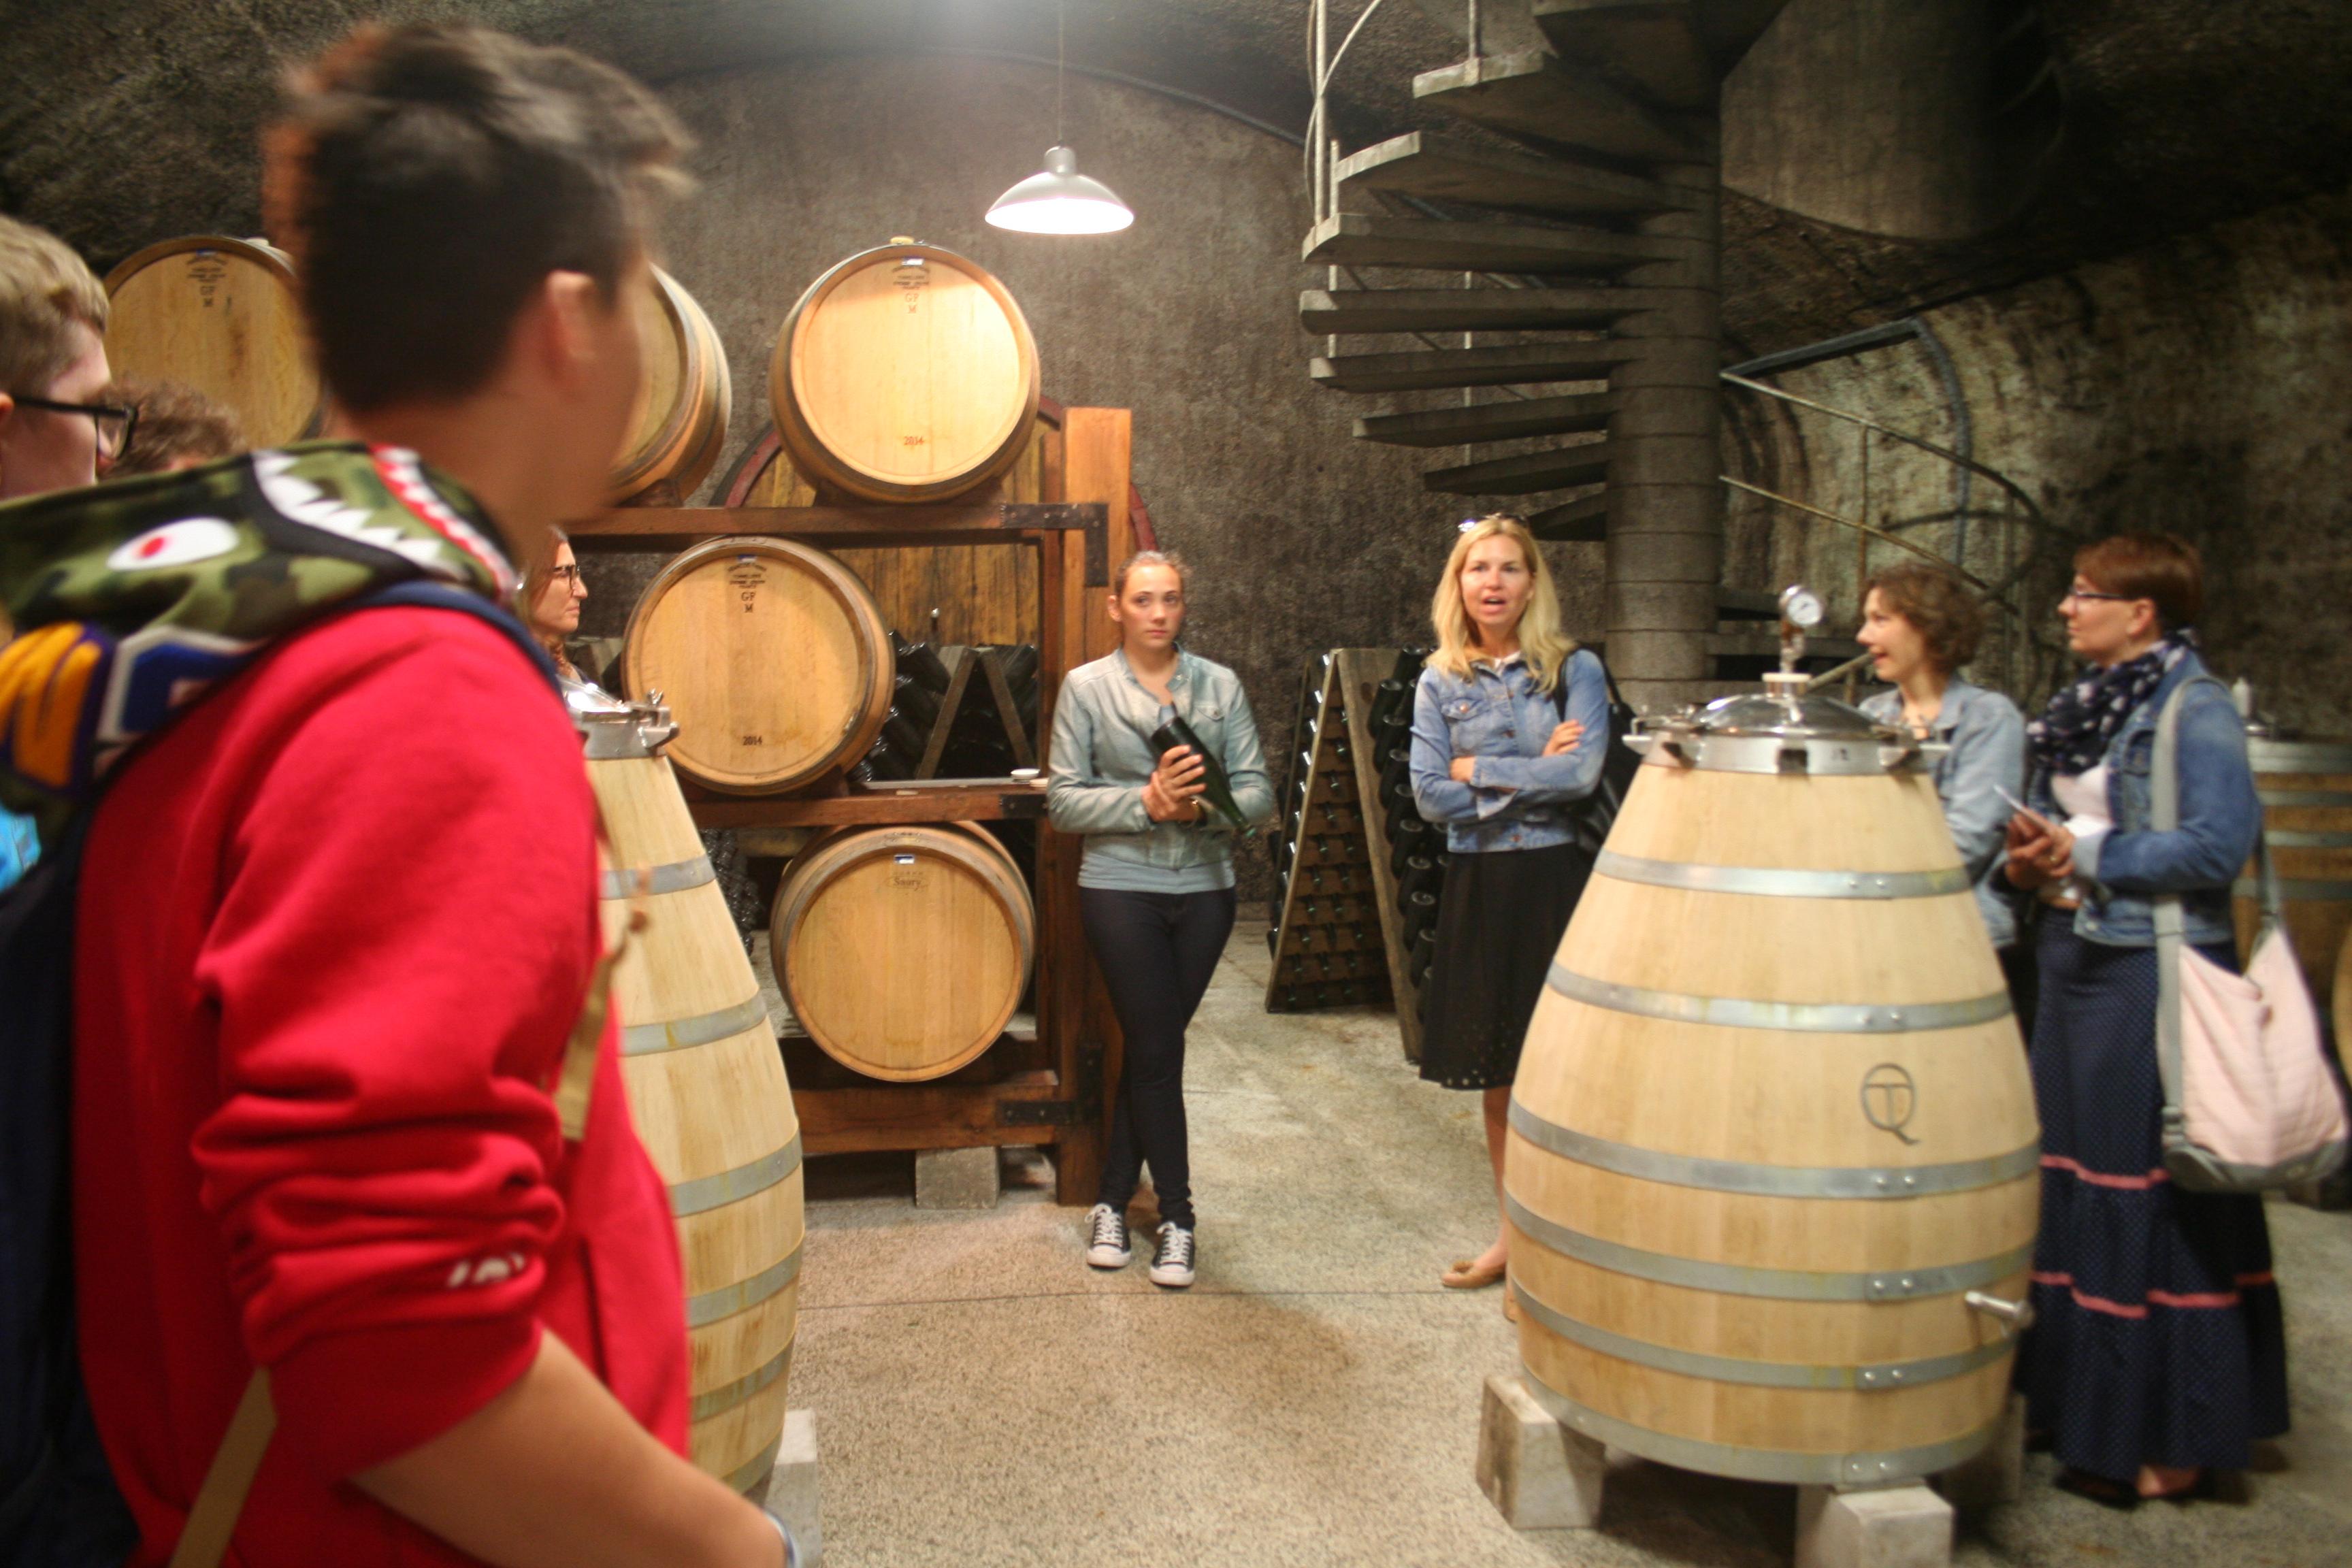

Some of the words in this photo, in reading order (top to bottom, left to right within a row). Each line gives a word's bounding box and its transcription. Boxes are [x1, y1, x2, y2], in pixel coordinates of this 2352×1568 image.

[904, 436, 924, 446] 2014
[744, 603, 754, 613] M
[742, 735, 763, 746] 2014
